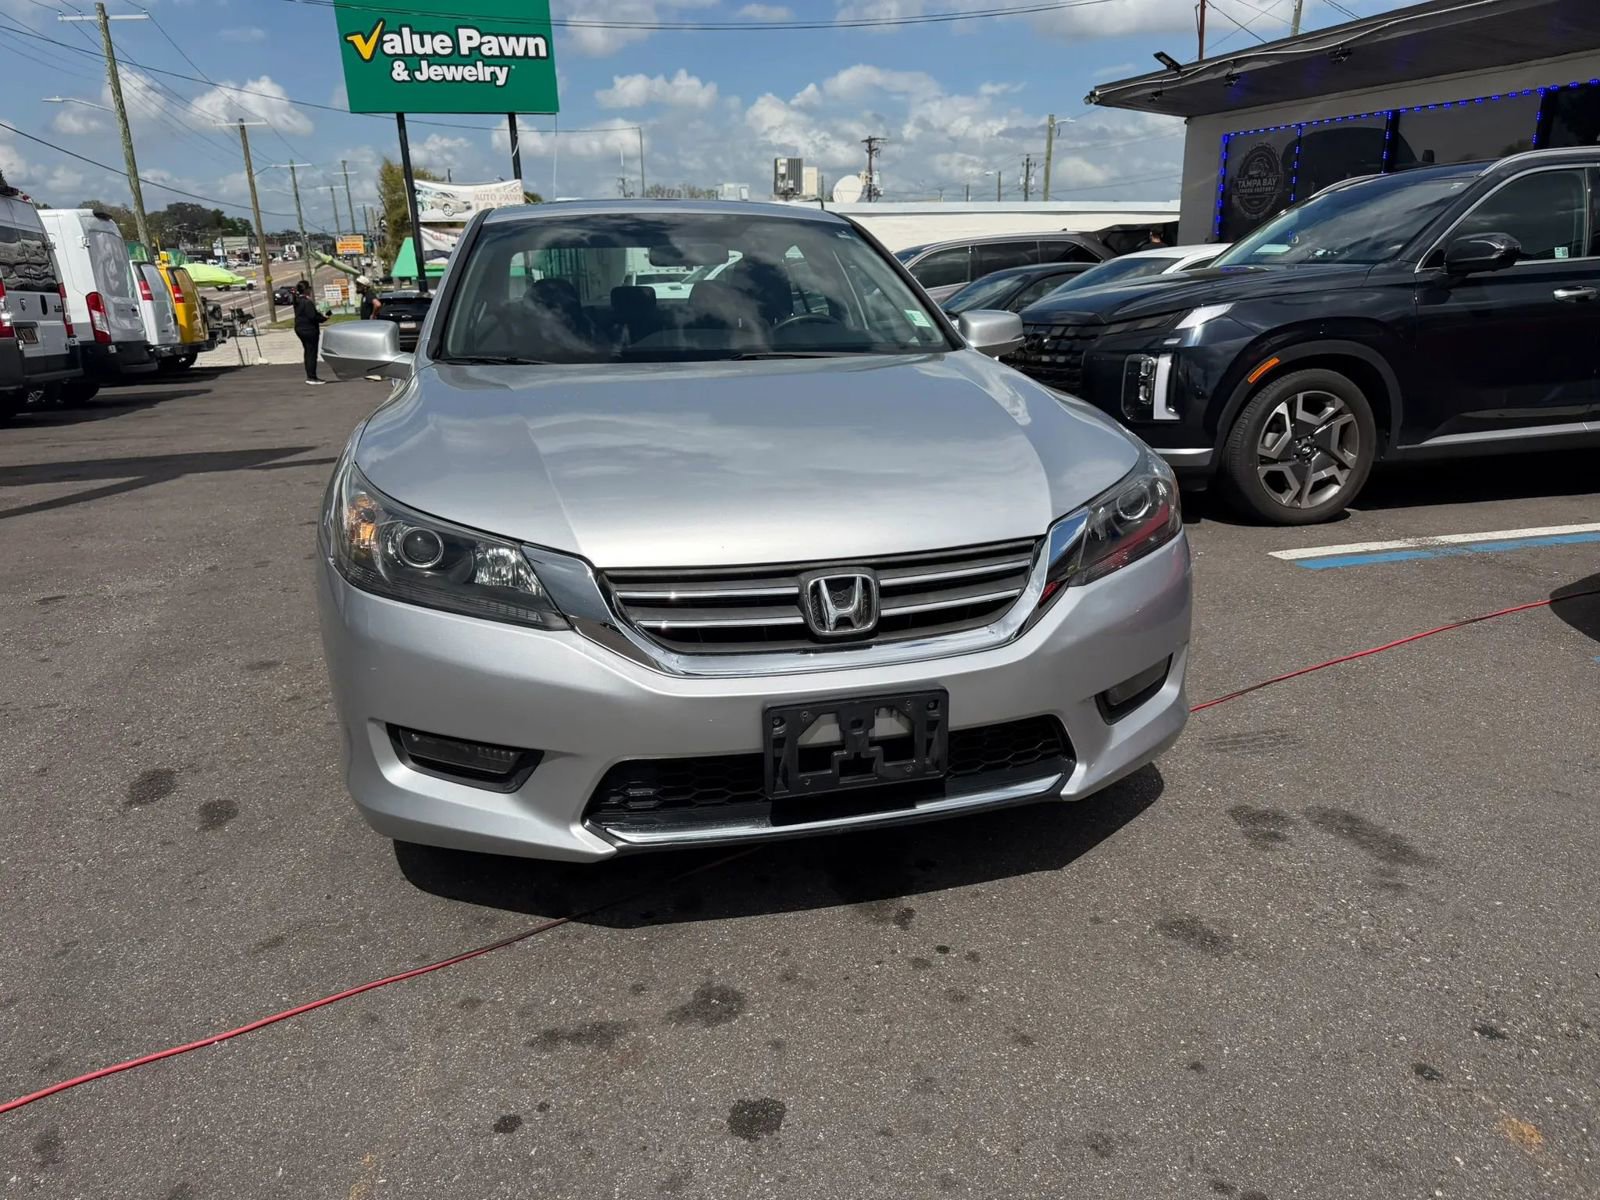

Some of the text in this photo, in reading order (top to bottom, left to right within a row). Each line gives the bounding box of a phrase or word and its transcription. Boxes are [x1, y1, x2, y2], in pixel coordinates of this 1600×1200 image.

[457, 27, 548, 57] Pawn
[391, 60, 509, 86] & Jewelry
[1238, 177, 1278, 188] TAMPA BAY
